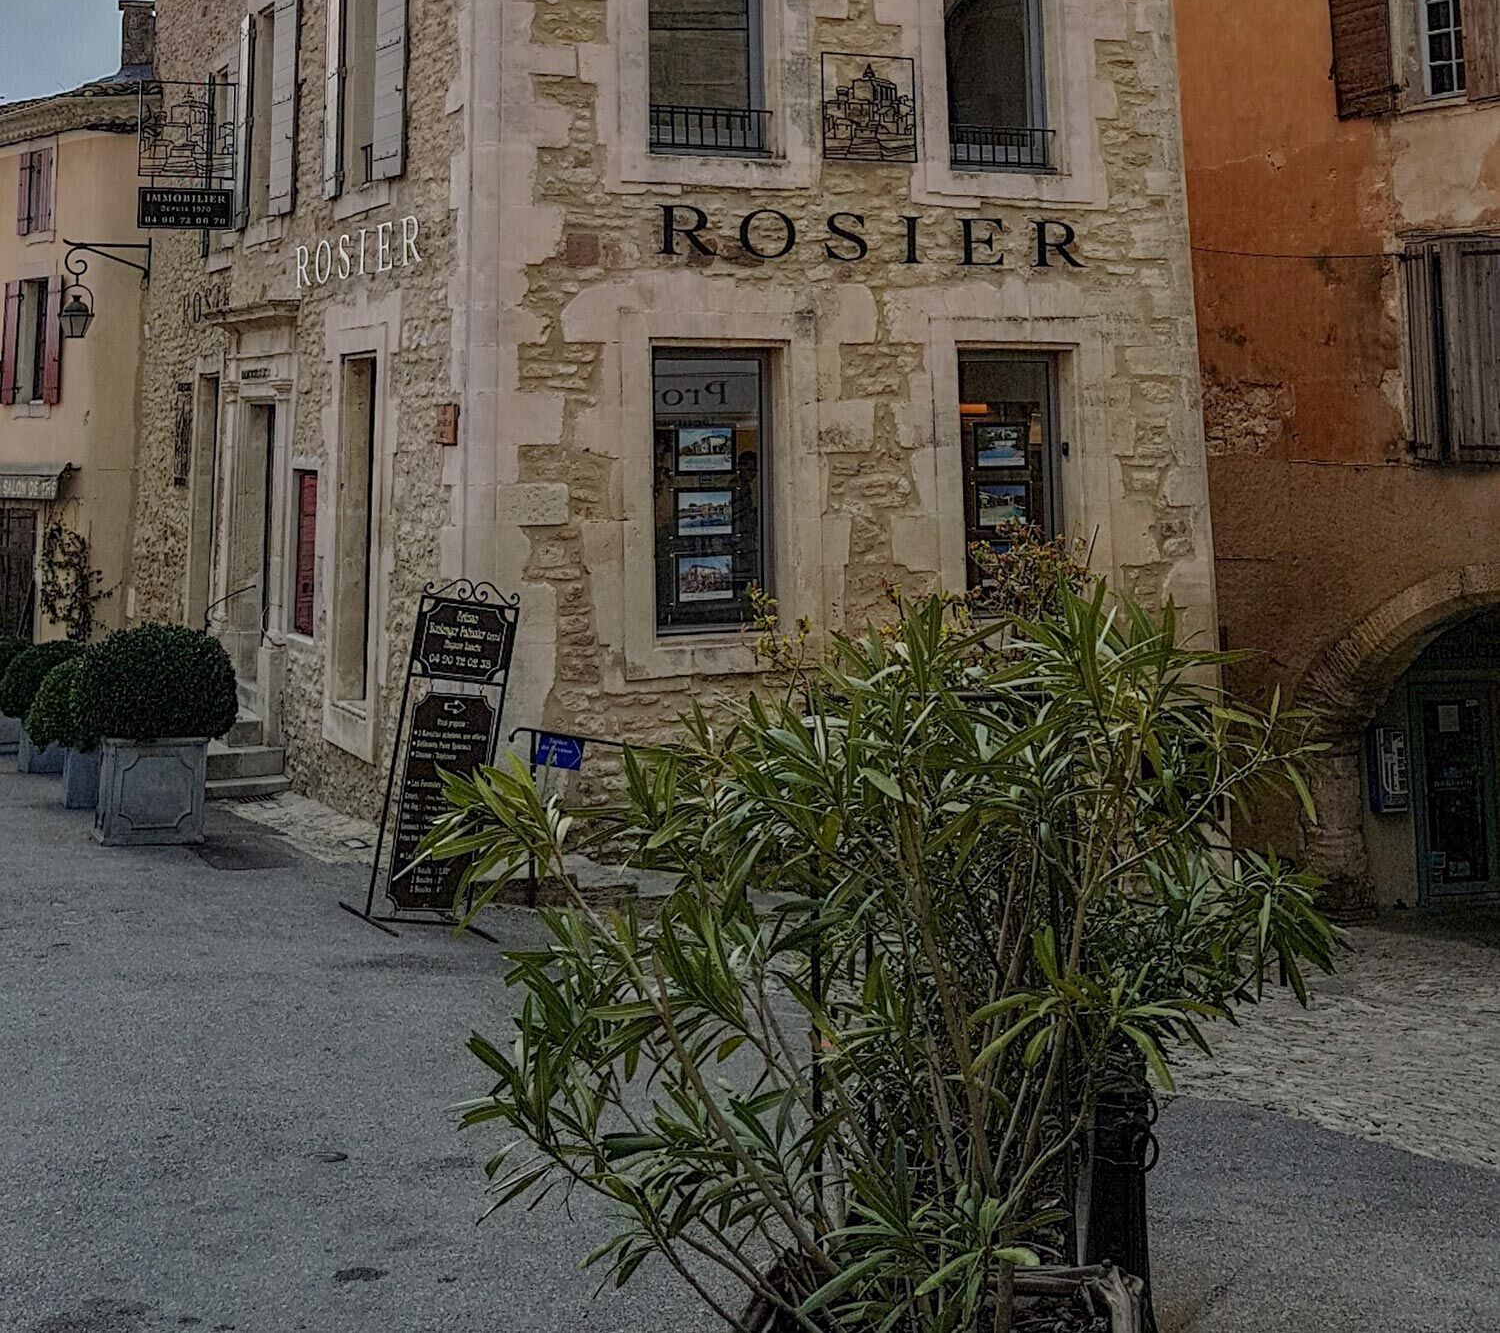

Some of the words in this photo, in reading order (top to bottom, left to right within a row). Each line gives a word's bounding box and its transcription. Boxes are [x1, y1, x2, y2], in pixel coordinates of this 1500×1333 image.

[146, 193, 226, 204] IMMOBILIER
[144, 216, 157, 224] 04
[653, 203, 1087, 269] ROSIER
[295, 215, 423, 289] ROSIER
[3, 478, 27, 496] SALON
[29, 480, 39, 497] DE
[429, 653, 441, 664] 04
[442, 654, 454, 665] 90
